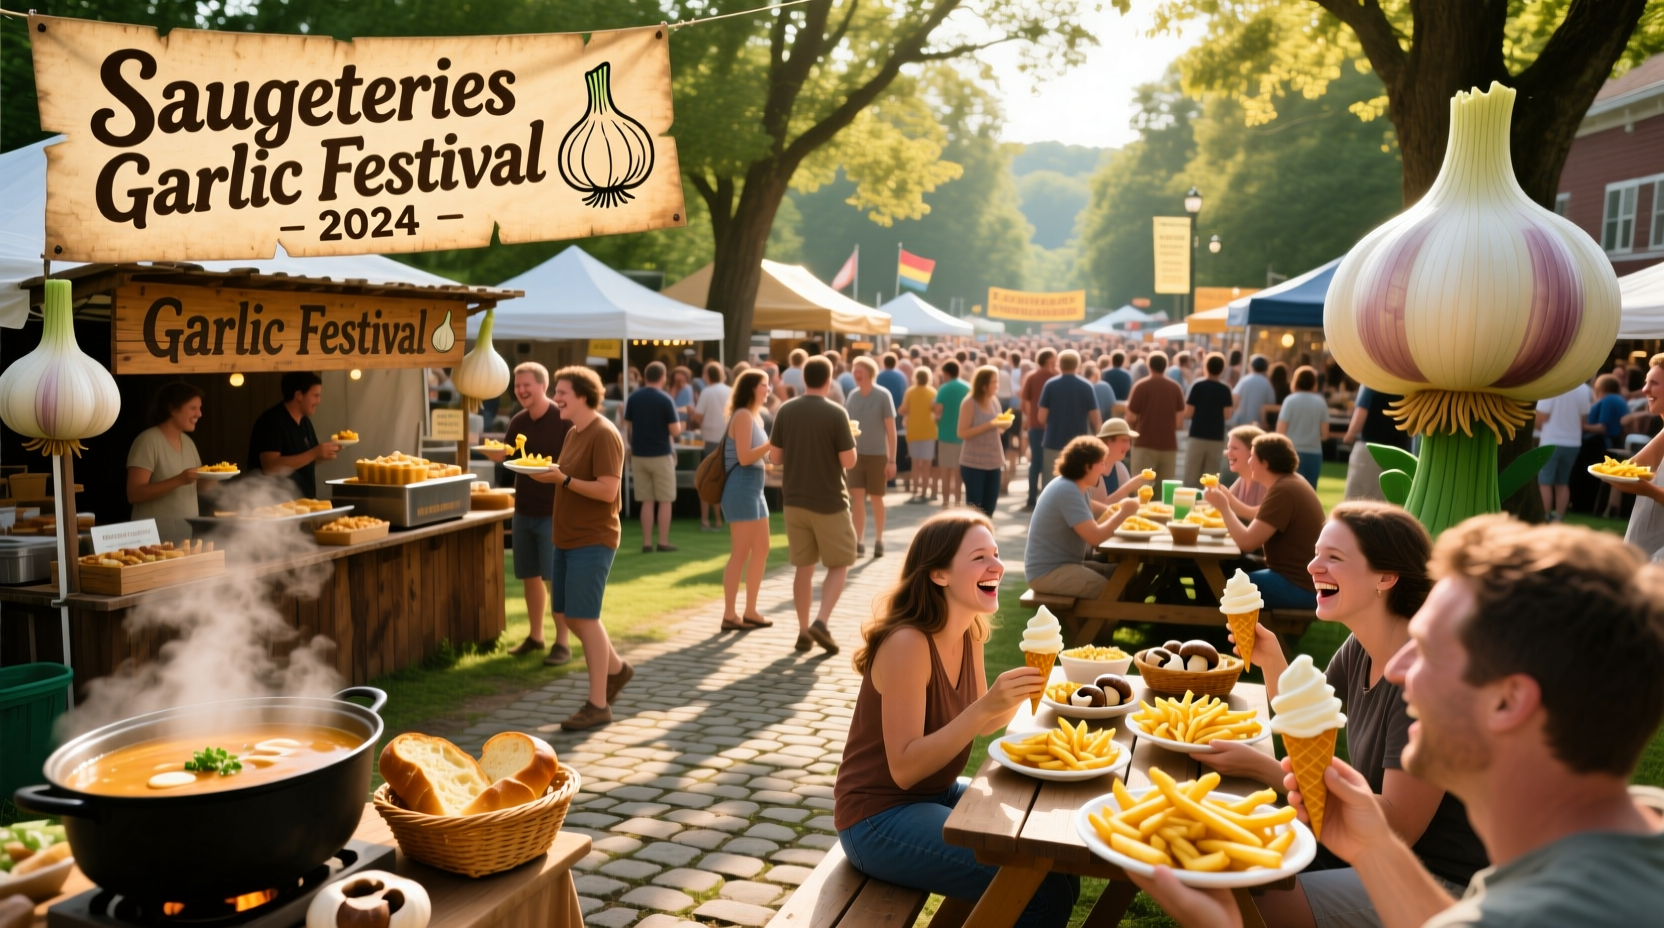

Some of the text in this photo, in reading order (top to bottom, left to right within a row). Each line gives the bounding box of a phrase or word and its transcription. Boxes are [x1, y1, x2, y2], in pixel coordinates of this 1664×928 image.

[90, 48, 516, 149] Saugeteries
[95, 119, 547, 229] Garlic Festival
[318, 204, 420, 241] 2024
[142, 297, 427, 363] Garlic Festival
